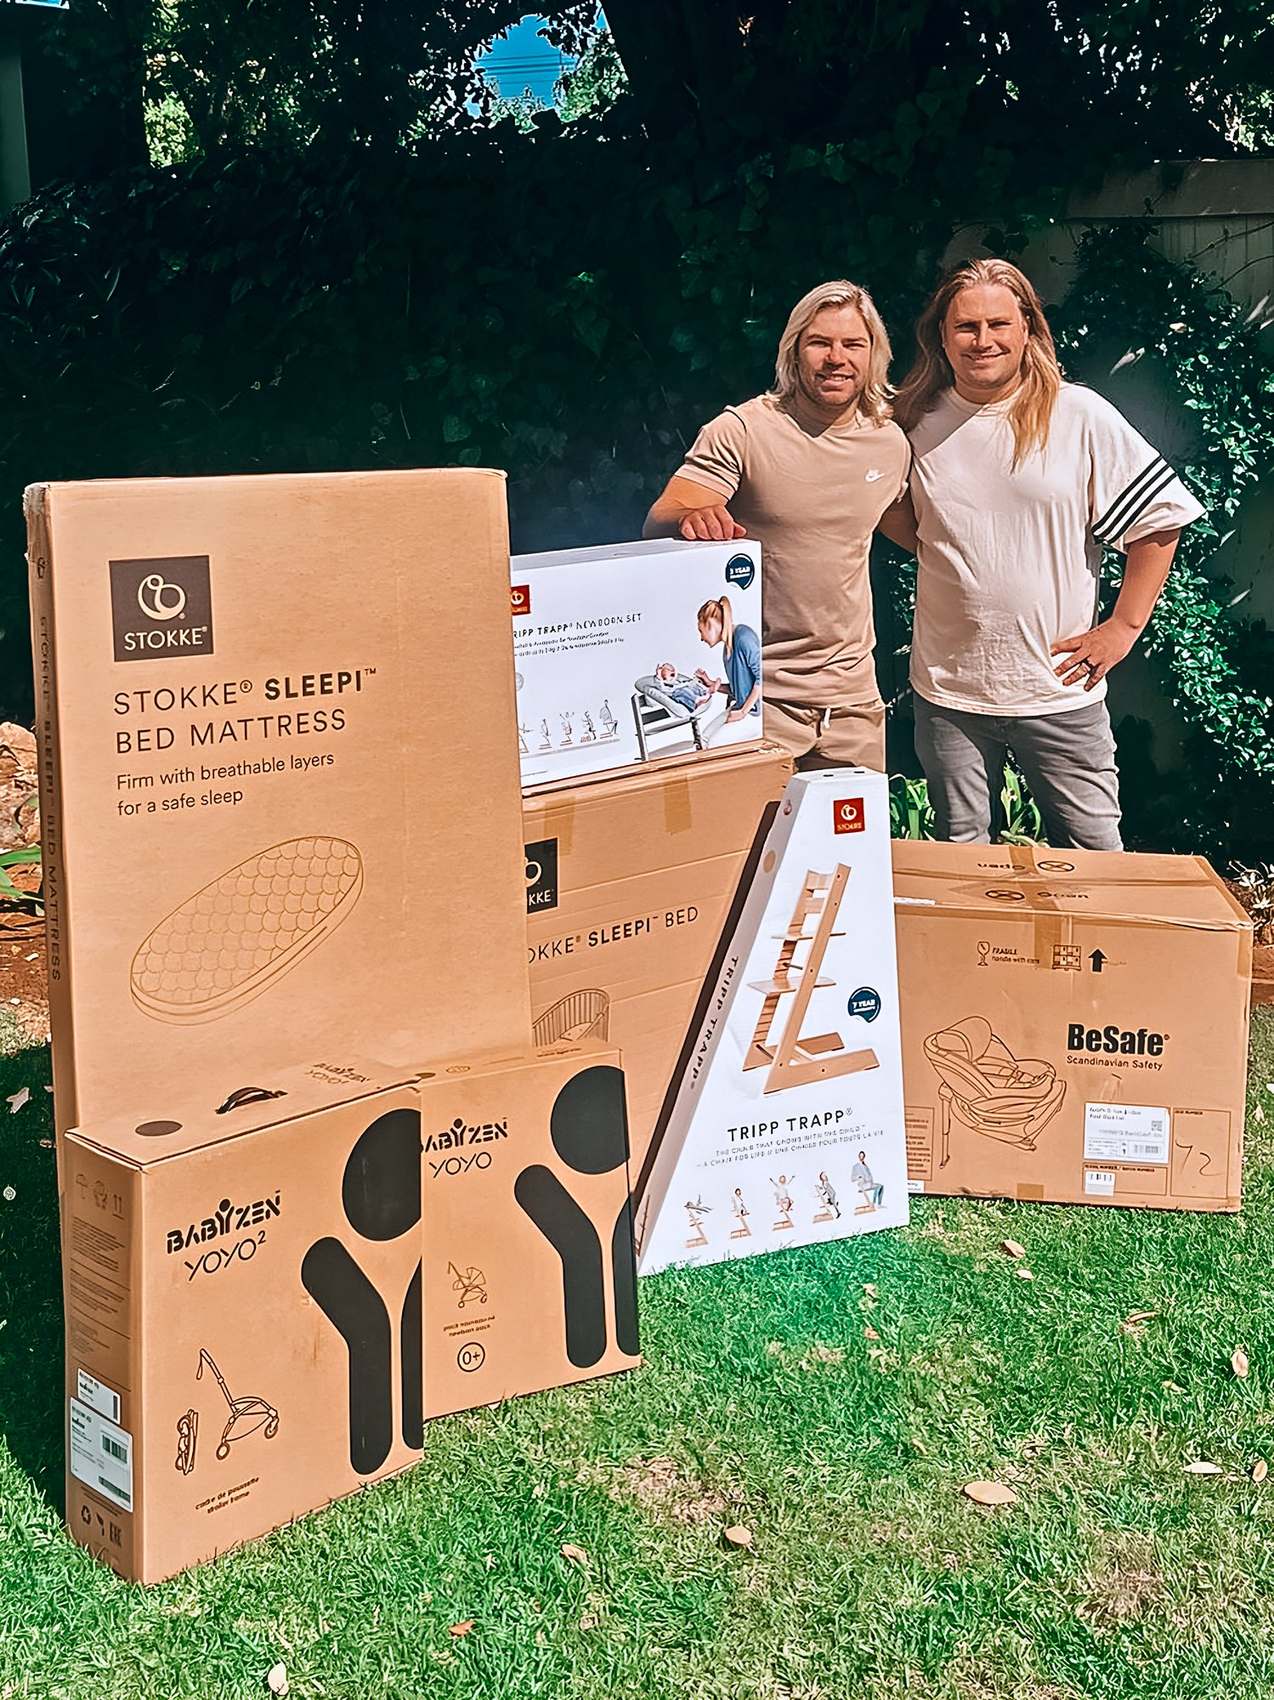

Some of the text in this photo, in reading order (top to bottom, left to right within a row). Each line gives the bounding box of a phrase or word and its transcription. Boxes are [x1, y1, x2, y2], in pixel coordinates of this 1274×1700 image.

[513, 628, 534, 639] RIPP
[626, 612, 642, 624] SET
[116, 708, 346, 755] BED MATTRESS
[117, 753, 335, 790] Firm with breathable layers
[118, 789, 244, 816] for a safe sleep
[528, 888, 553, 906] KKE
[48, 864, 61, 982] MATTRESS
[665, 906, 699, 928] BED
[717, 956, 739, 1011] TRIPP
[1066, 1055, 1163, 1072] Scandinavian Safety
[421, 1118, 508, 1153] ABYZEN
[727, 1121, 779, 1142] TRIPP
[428, 1152, 492, 1178] YOYO
[462, 1351, 481, 1365] 0+
